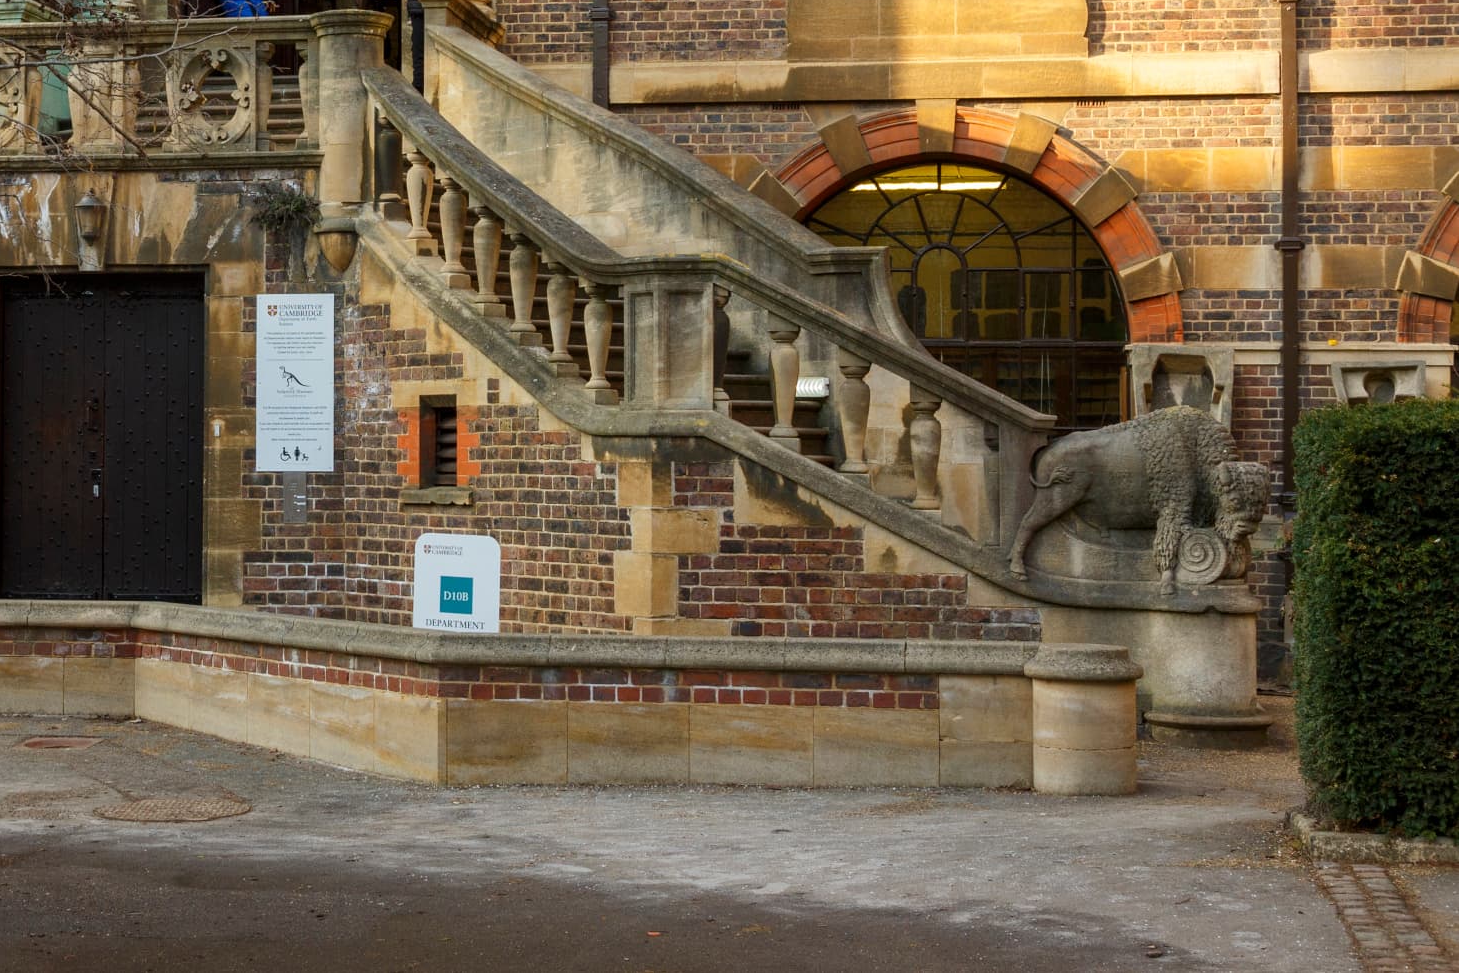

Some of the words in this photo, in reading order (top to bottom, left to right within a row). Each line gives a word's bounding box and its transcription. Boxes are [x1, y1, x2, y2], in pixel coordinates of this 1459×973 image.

[279, 309, 324, 317] CAMBRIDGE
[443, 590, 469, 602] D10B
[425, 618, 486, 630] DEPARTMENT
